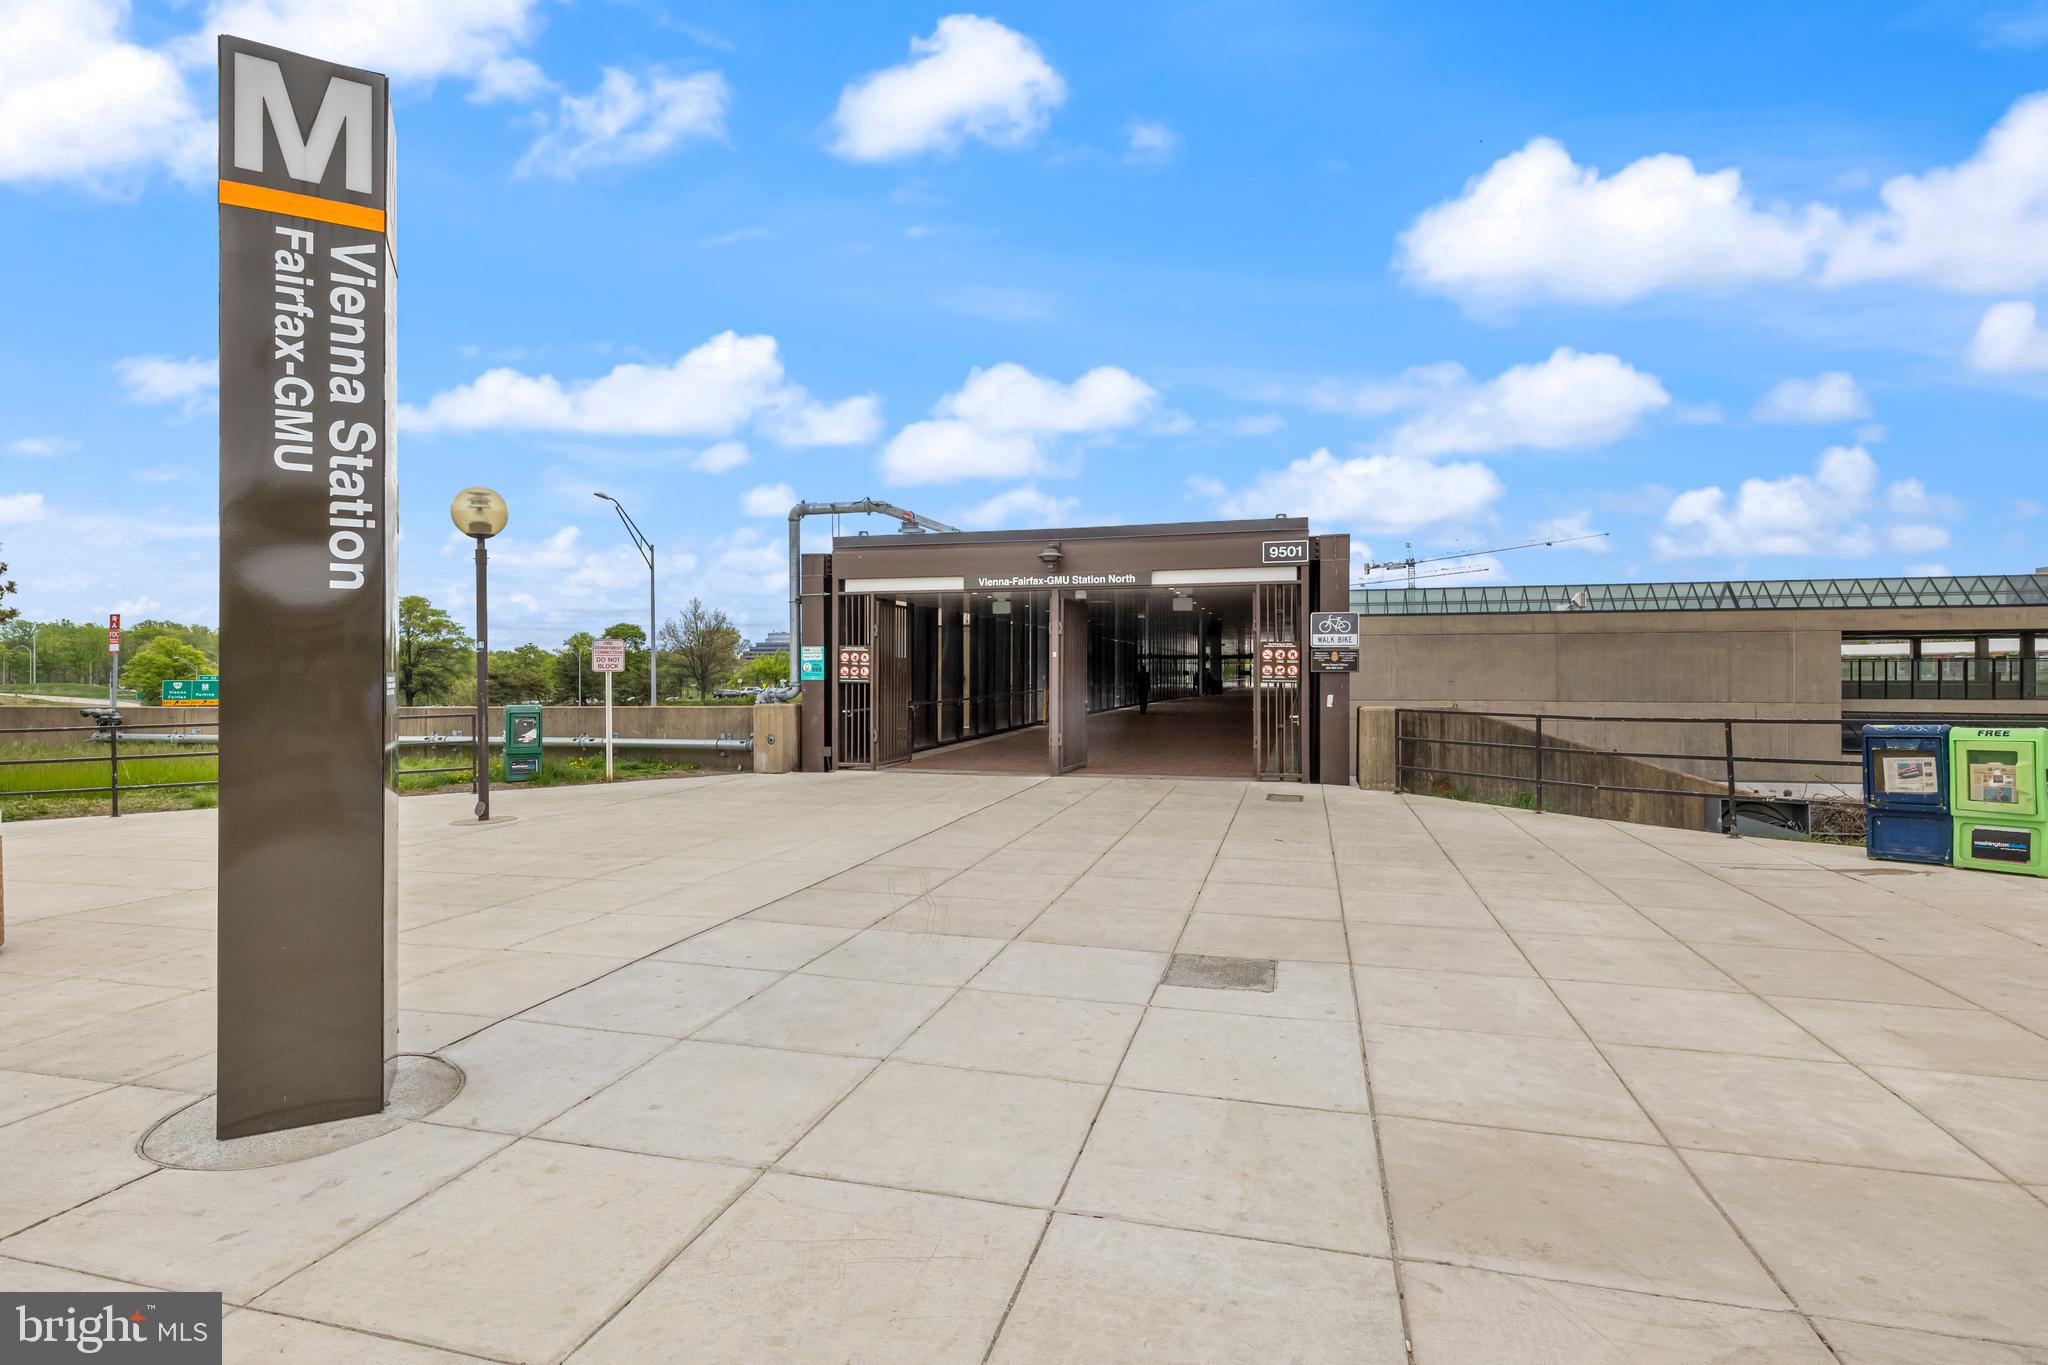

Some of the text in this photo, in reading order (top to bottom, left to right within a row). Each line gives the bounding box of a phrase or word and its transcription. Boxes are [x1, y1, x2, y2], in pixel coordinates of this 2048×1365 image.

[234, 52, 373, 194] M
[274, 225, 314, 473] Fairfax-GMU
[329, 244, 377, 590] Vienna Station
[978, 574, 1136, 587] Vienna-Fairfax-GMU Station North
[1269, 546, 1303, 558] 9501
[1977, 729, 2011, 737] FREE
